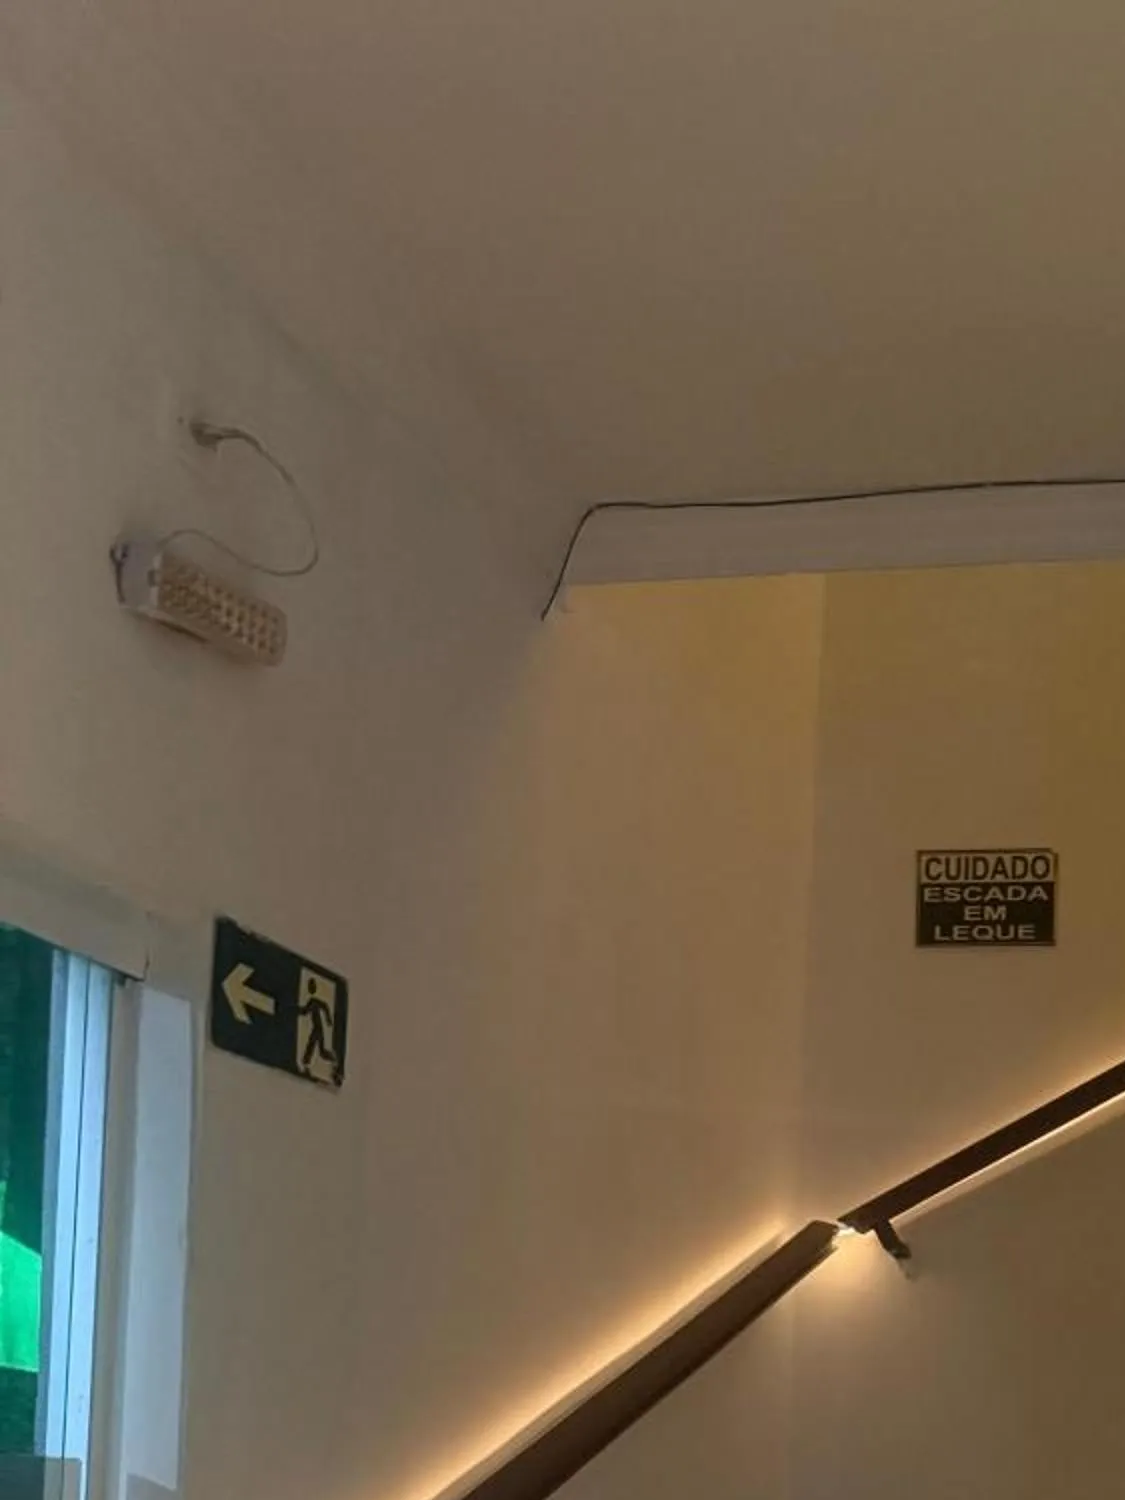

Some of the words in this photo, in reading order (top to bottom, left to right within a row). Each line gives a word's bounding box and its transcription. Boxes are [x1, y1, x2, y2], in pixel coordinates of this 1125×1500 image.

[925, 855, 1050, 881] CUIDADO
[923, 885, 1049, 903] ESCADA
[963, 905, 1008, 921] EM
[933, 924, 1037, 941] LEQUE
